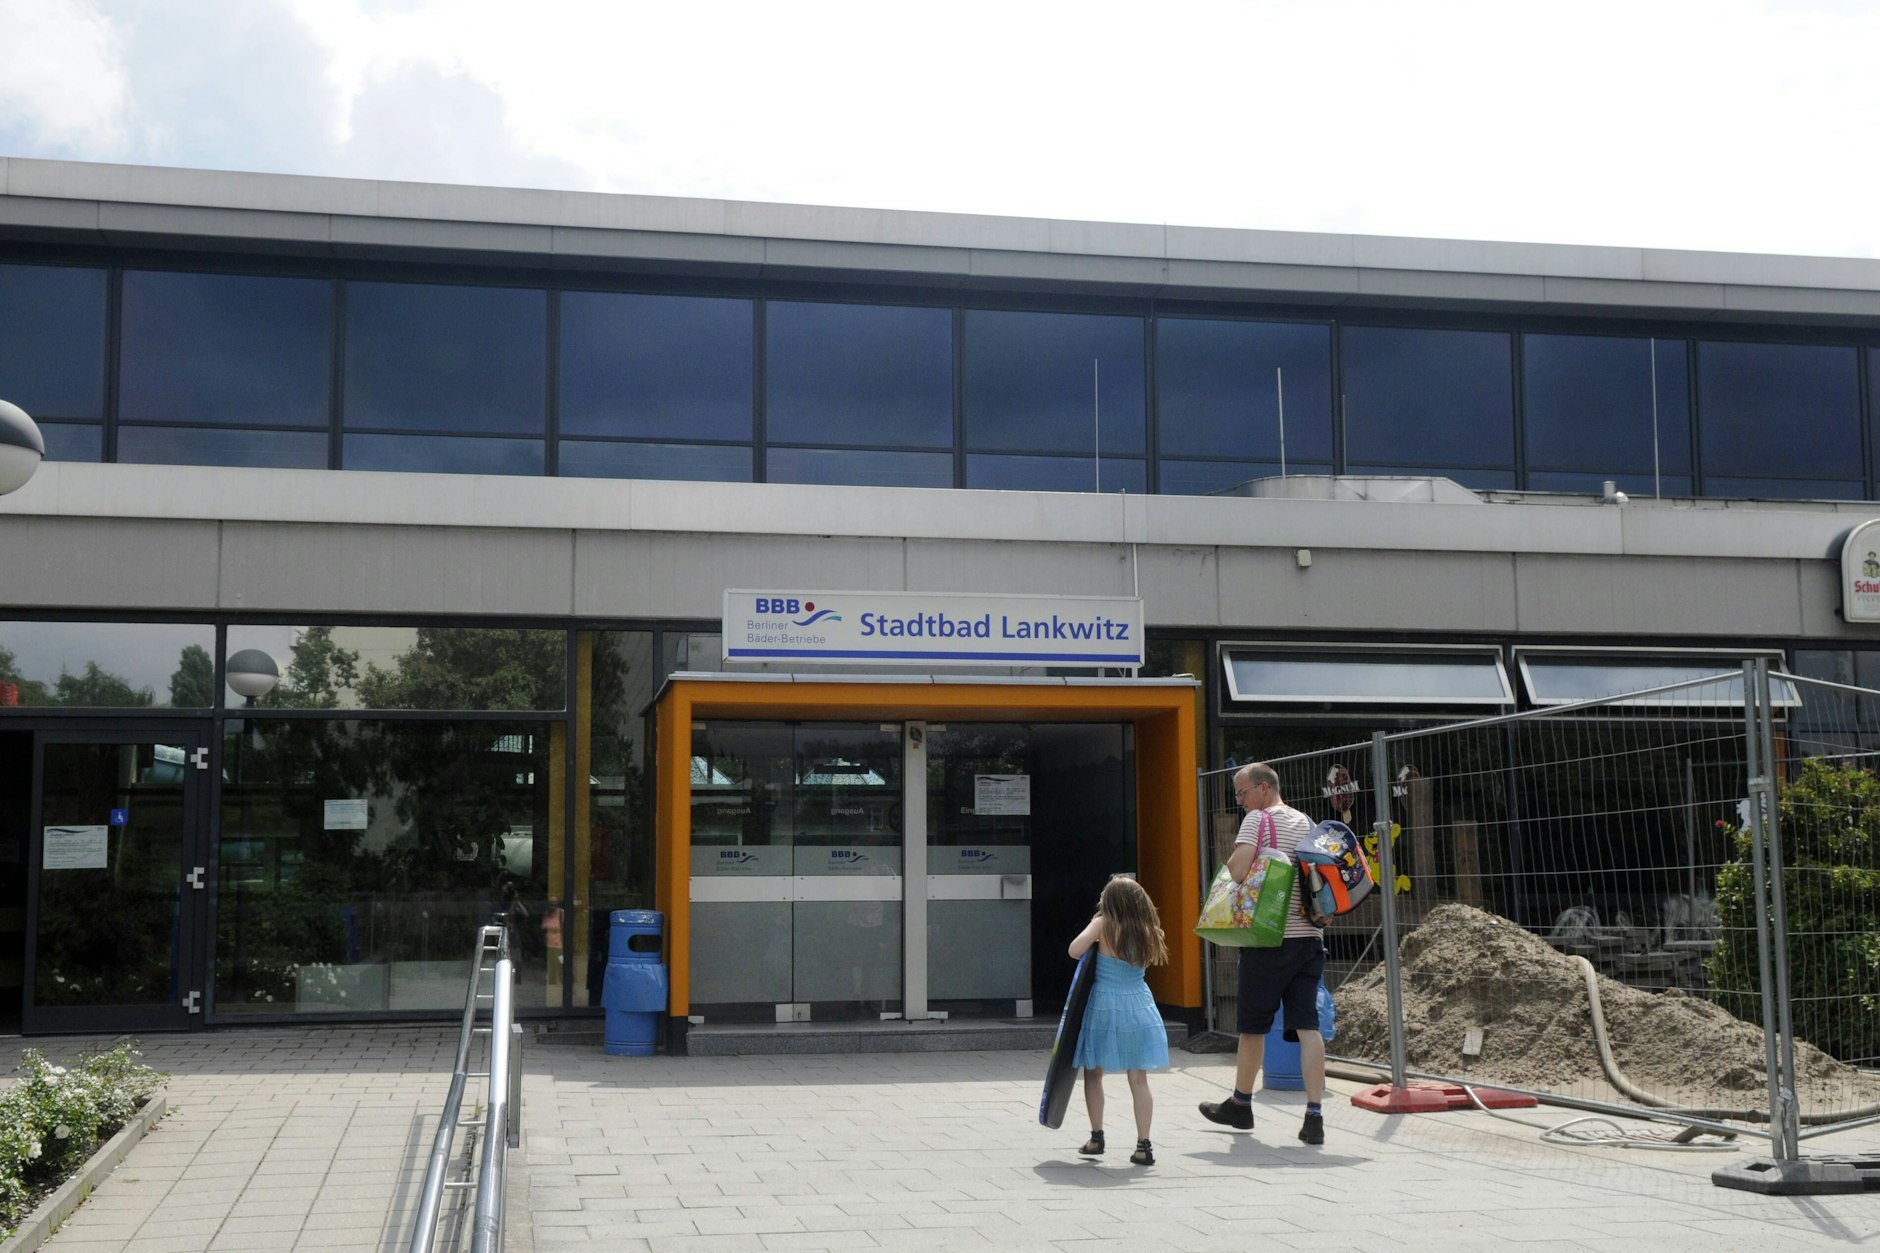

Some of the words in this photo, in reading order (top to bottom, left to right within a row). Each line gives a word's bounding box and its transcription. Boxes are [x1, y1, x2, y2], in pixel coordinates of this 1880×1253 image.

[1855, 580, 1880, 592] Schu
[755, 598, 800, 614] BBB
[747, 620, 788, 630] Berliner
[860, 612, 990, 638] Stadtbad
[1001, 615, 1129, 640] Lankwitz
[747, 633, 826, 644] Bäder-Betriebe
[720, 850, 740, 858] BBB
[831, 850, 850, 858] BBB
